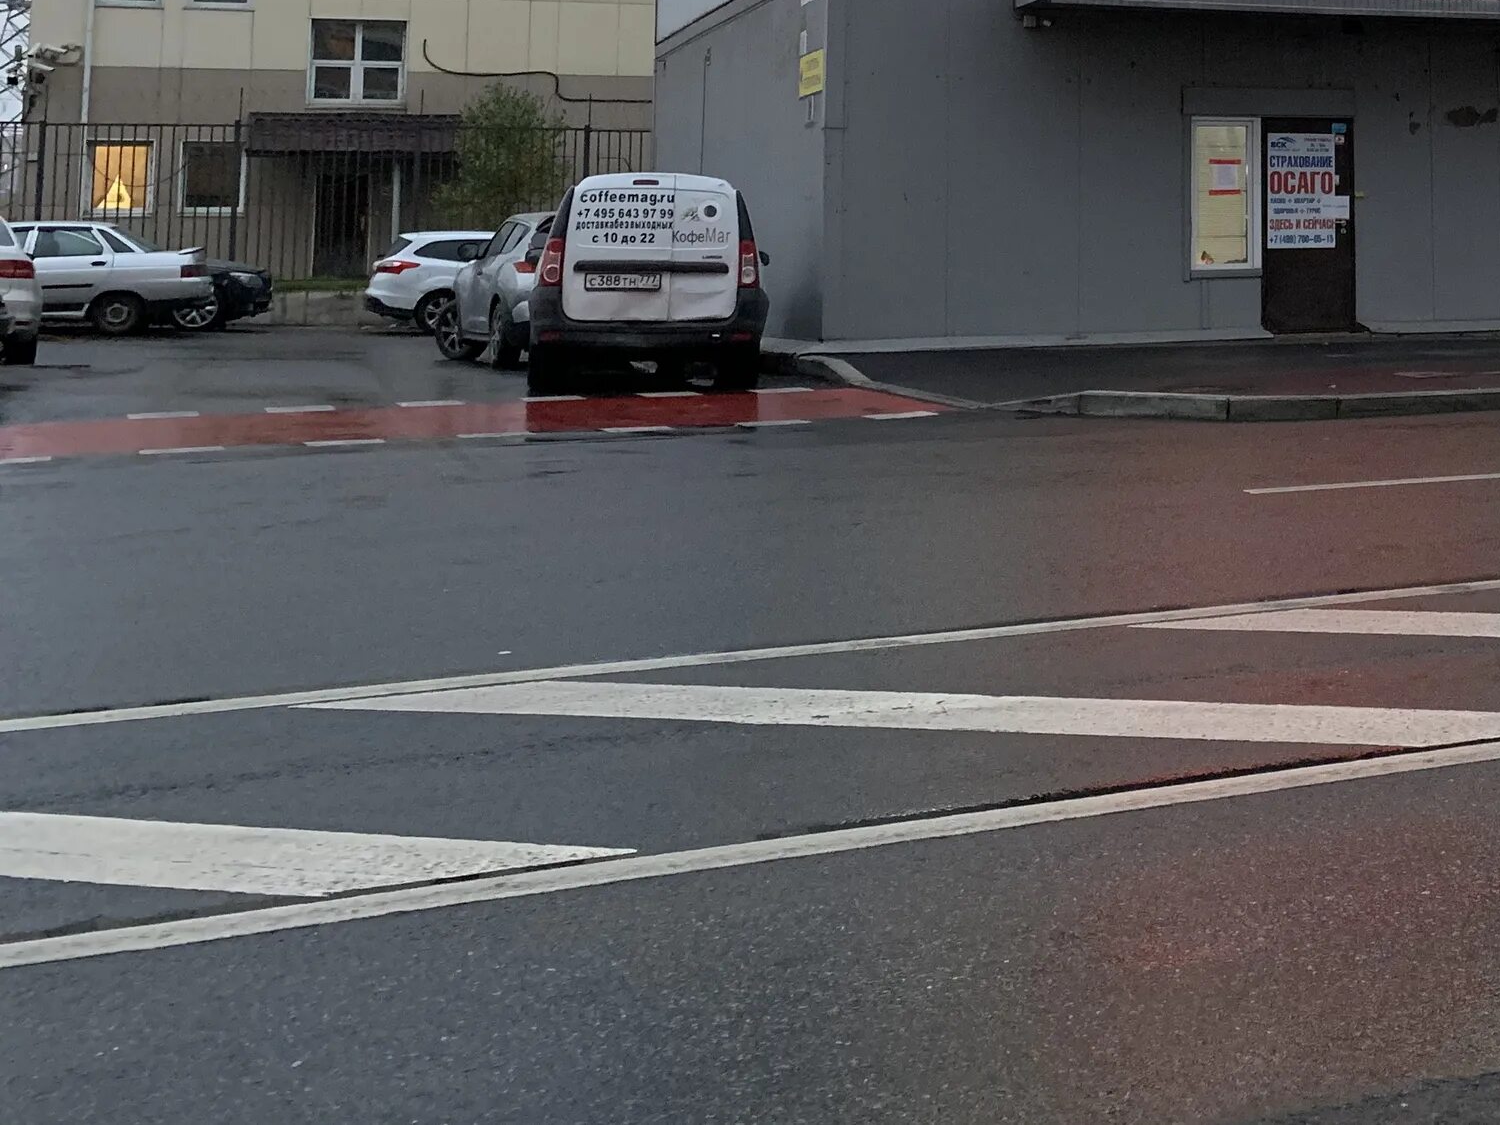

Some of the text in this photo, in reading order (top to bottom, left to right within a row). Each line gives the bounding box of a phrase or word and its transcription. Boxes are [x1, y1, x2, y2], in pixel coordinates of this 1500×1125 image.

[1269, 156, 1333, 168] СТРАХОВАНИЕ
[1269, 170, 1333, 194] ОСАГО
[580, 191, 675, 206] coffeemag.ru
[577, 208, 674, 219] +7 495 643 97 99
[1270, 219, 1293, 231] ЗДЕСЬ
[603, 232, 618, 243] 10
[621, 235, 636, 245] до
[640, 233, 655, 243] 22
[671, 227, 731, 246] КофеМаг
